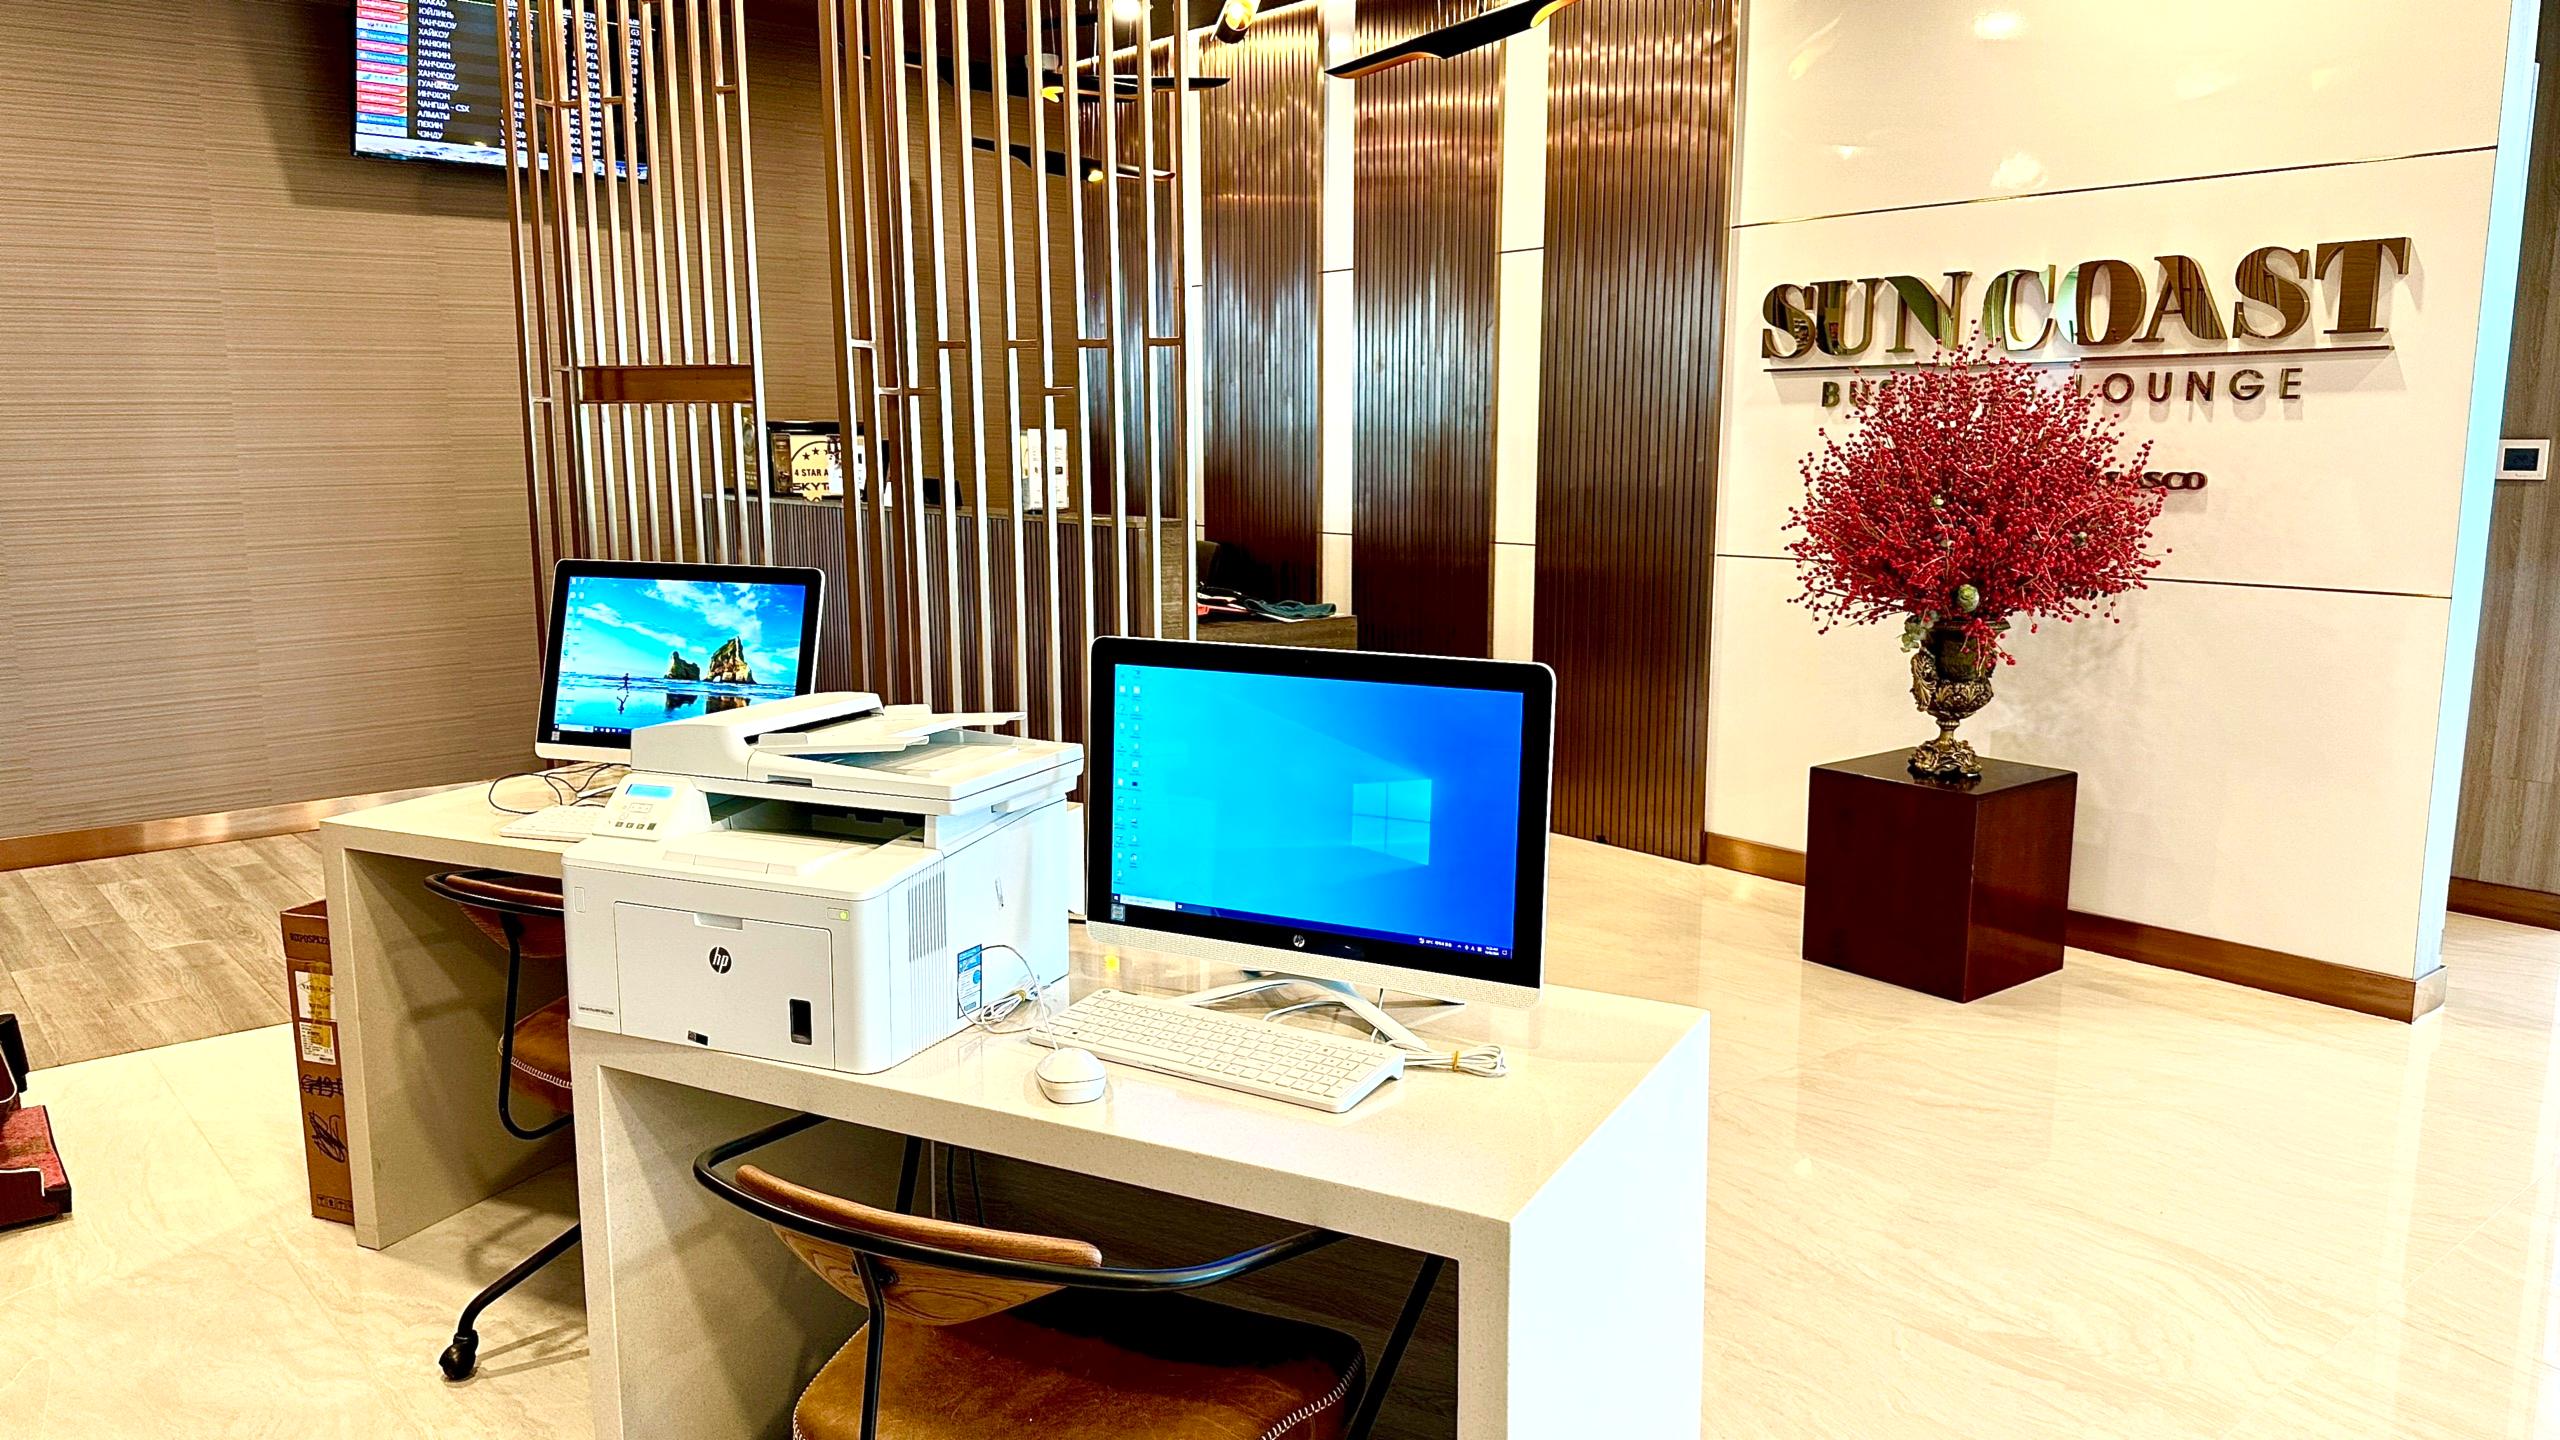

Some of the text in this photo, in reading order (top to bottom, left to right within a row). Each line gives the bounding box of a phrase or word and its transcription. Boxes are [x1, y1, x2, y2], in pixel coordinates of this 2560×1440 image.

[455, 103, 470, 113] CSX
[1761, 237, 2411, 359] SUNCOAST
[802, 469, 821, 477] STAR
[792, 482, 829, 491] SKYT
[2104, 471, 2208, 490] SCO
[710, 946, 731, 974] hp
